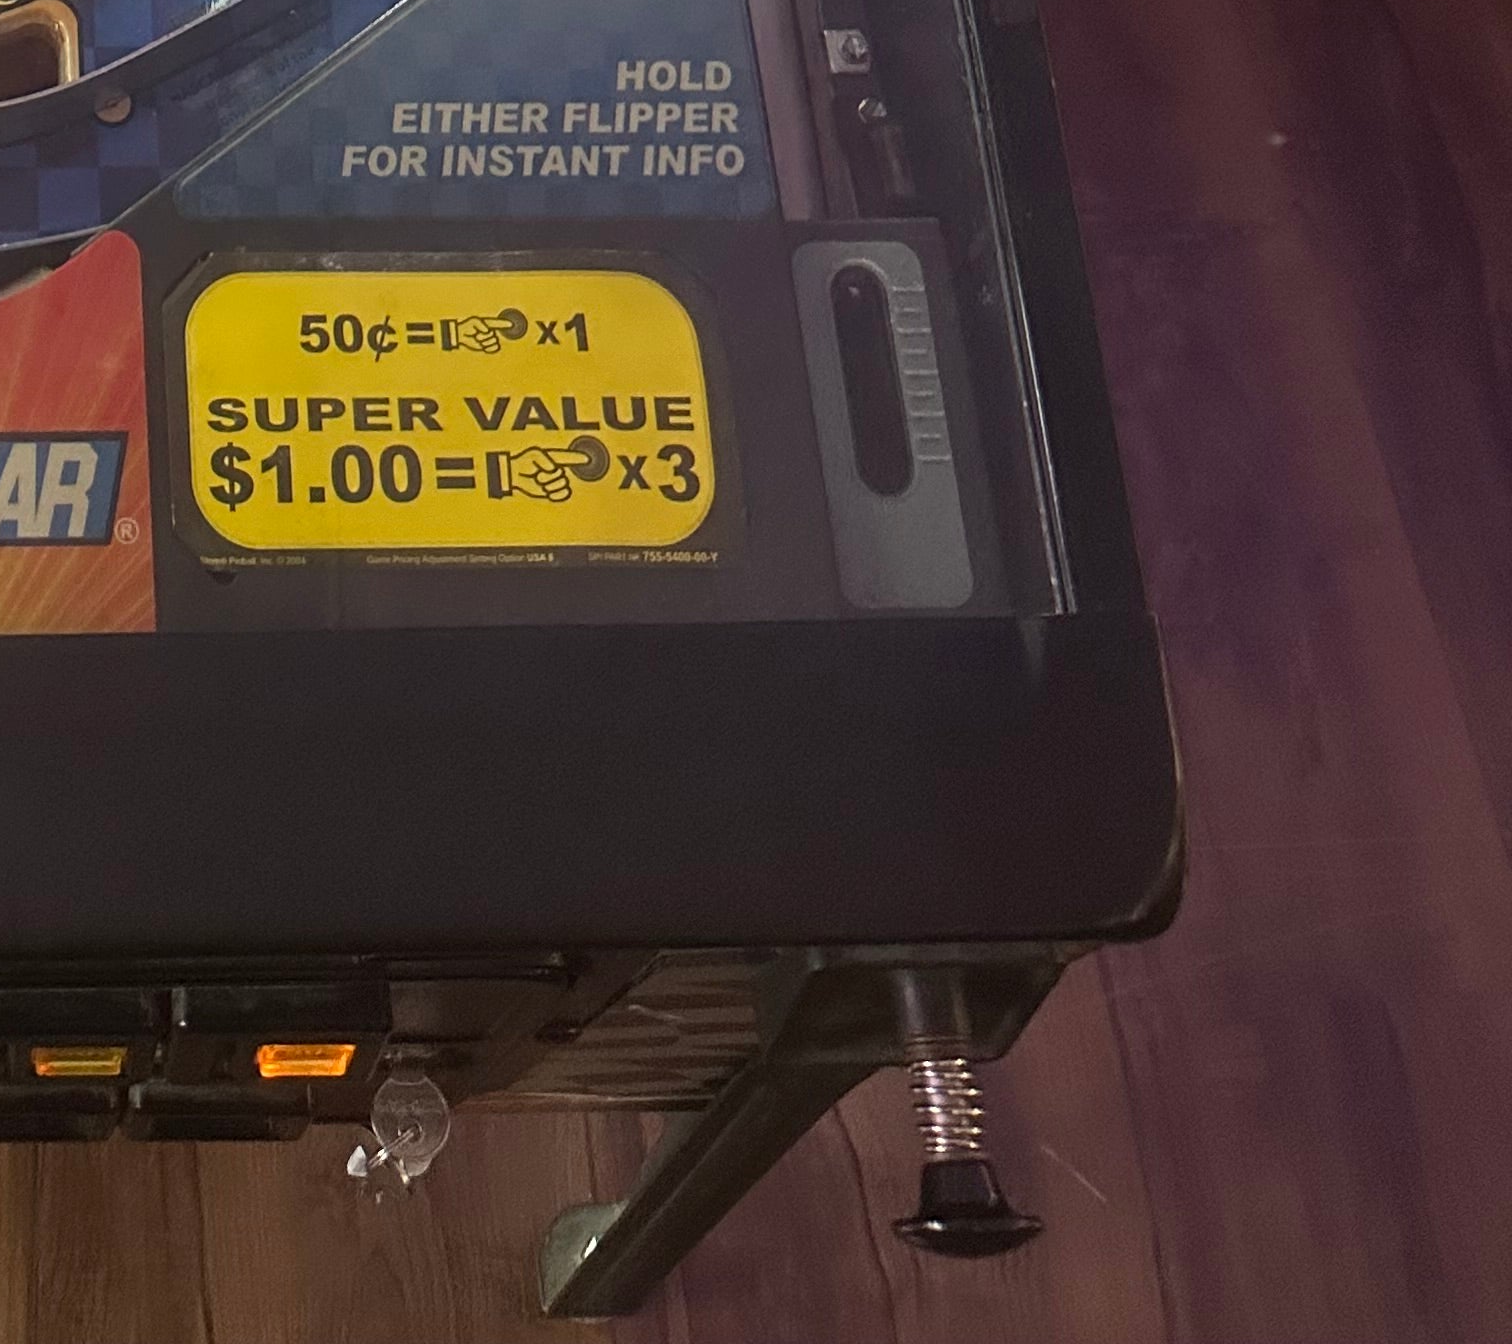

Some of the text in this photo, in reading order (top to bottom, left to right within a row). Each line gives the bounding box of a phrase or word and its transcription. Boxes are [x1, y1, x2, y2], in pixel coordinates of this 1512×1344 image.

[616, 60, 733, 92] HOLD
[392, 101, 739, 134] EITHER FLIPPER
[341, 144, 745, 177] FOR INSTANT INFO
[537, 312, 590, 353] x1
[207, 395, 695, 432] SUPER VALUE
[618, 443, 701, 503] x3
